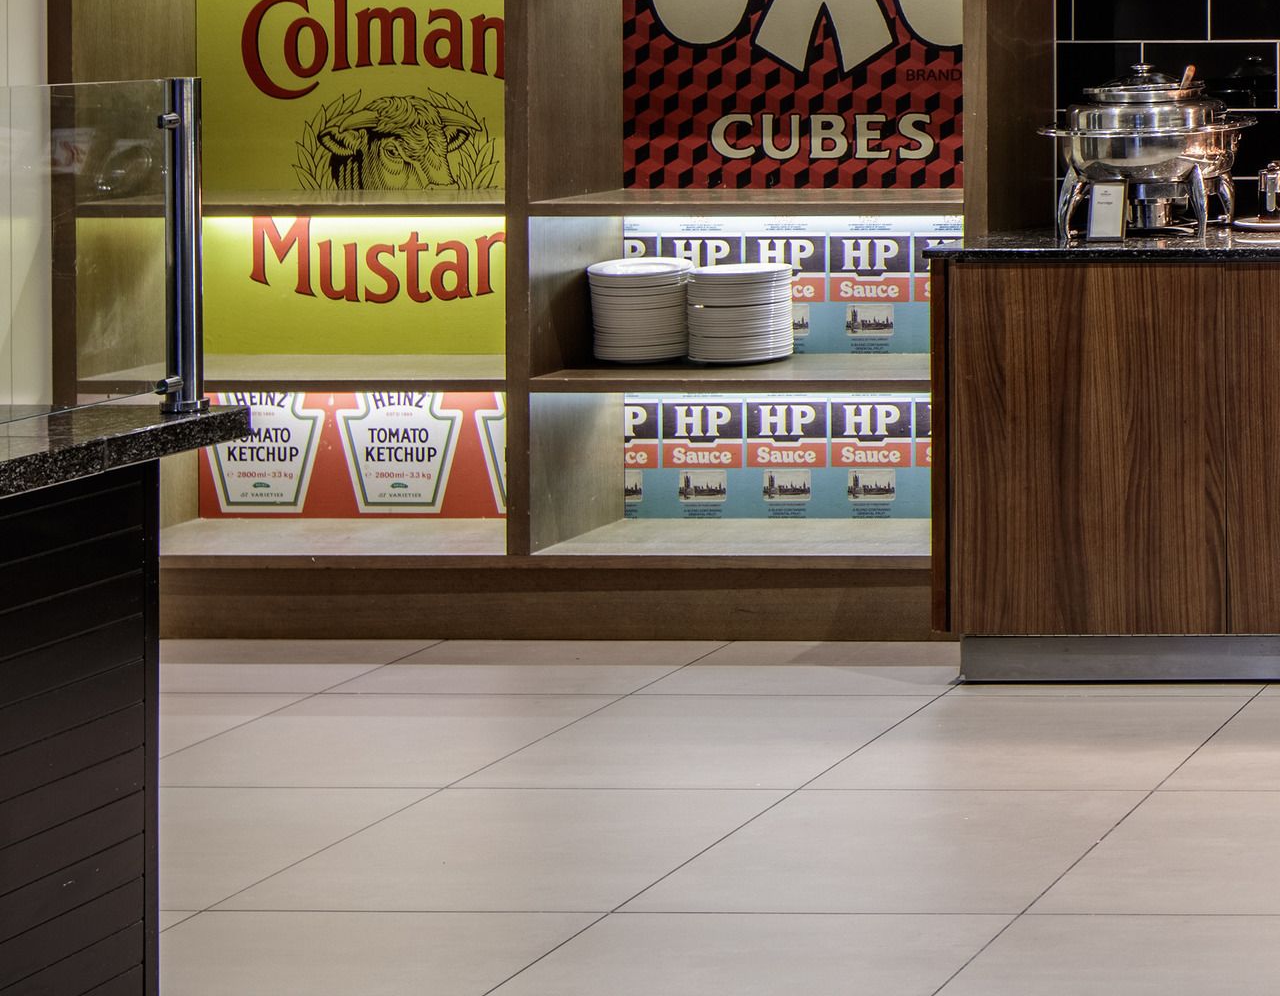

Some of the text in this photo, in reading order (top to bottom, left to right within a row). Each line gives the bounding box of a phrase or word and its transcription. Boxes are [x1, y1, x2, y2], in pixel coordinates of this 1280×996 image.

[905, 69, 962, 82] BRAND
[711, 113, 935, 159] CUBES
[674, 405, 731, 437] HP
[843, 404, 900, 435] HP
[368, 428, 428, 443] TOMATO
[227, 447, 299, 462] KETCHUP
[365, 447, 437, 462] KETCHUP
[673, 448, 732, 464] Sauce
[841, 446, 901, 464] Sauce
